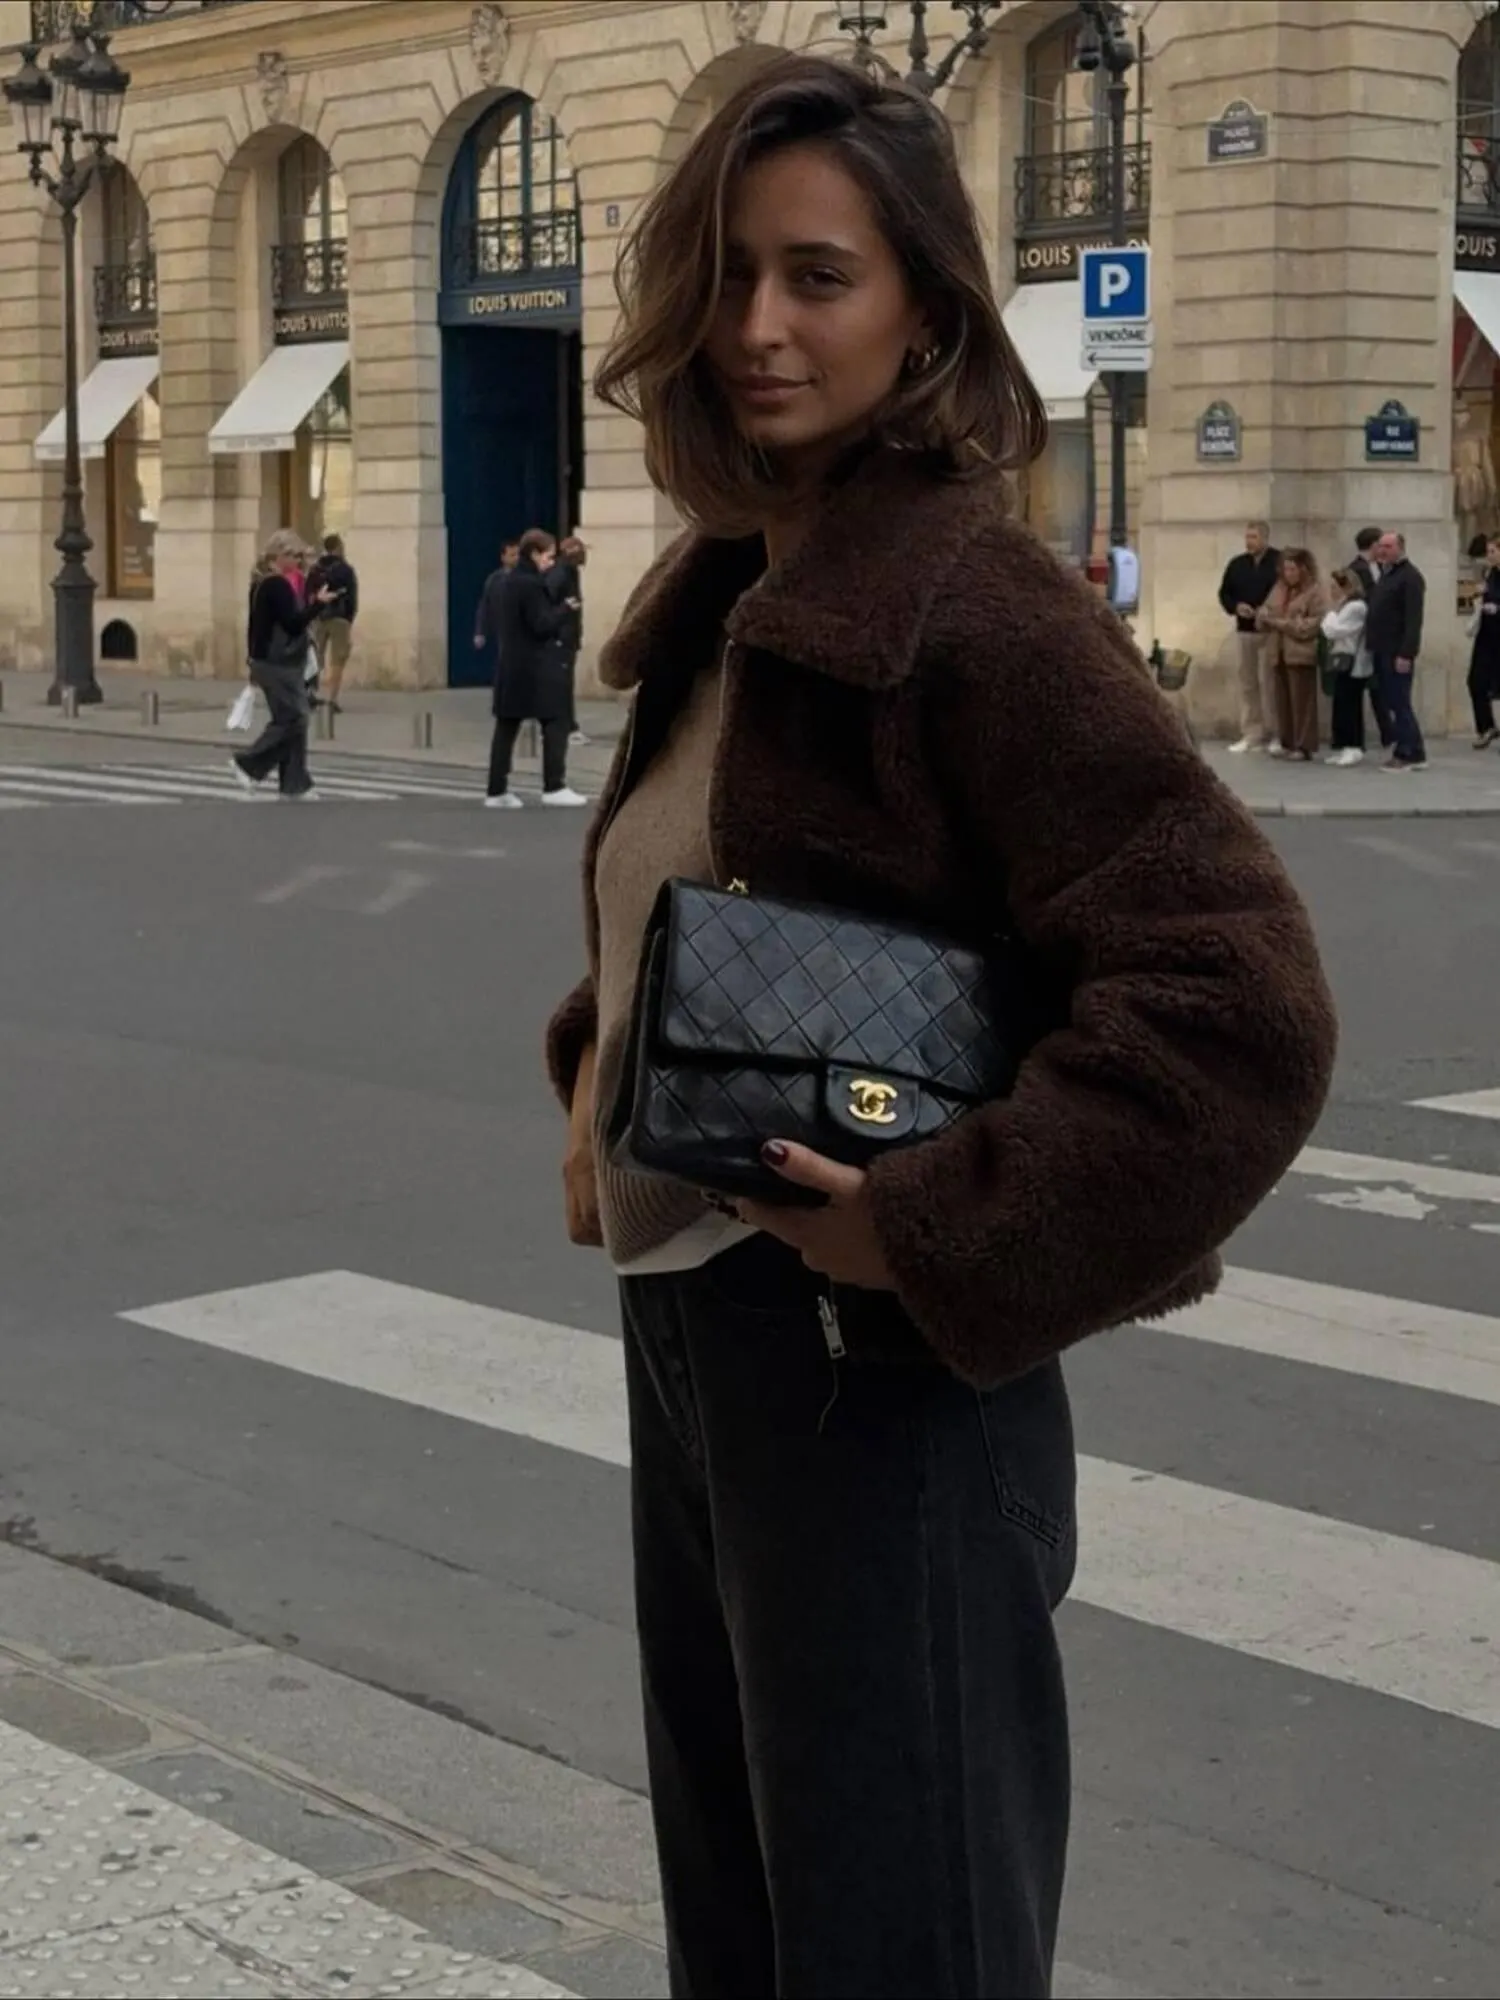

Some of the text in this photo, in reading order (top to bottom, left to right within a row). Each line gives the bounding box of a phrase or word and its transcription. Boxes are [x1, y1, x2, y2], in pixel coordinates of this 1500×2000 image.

[1019, 244, 1071, 268] LOUIS
[1455, 234, 1497, 257] OUIS
[1100, 263, 1131, 308] P
[469, 289, 567, 315] LOUIS VUITTON
[309, 311, 349, 331] VUITTO
